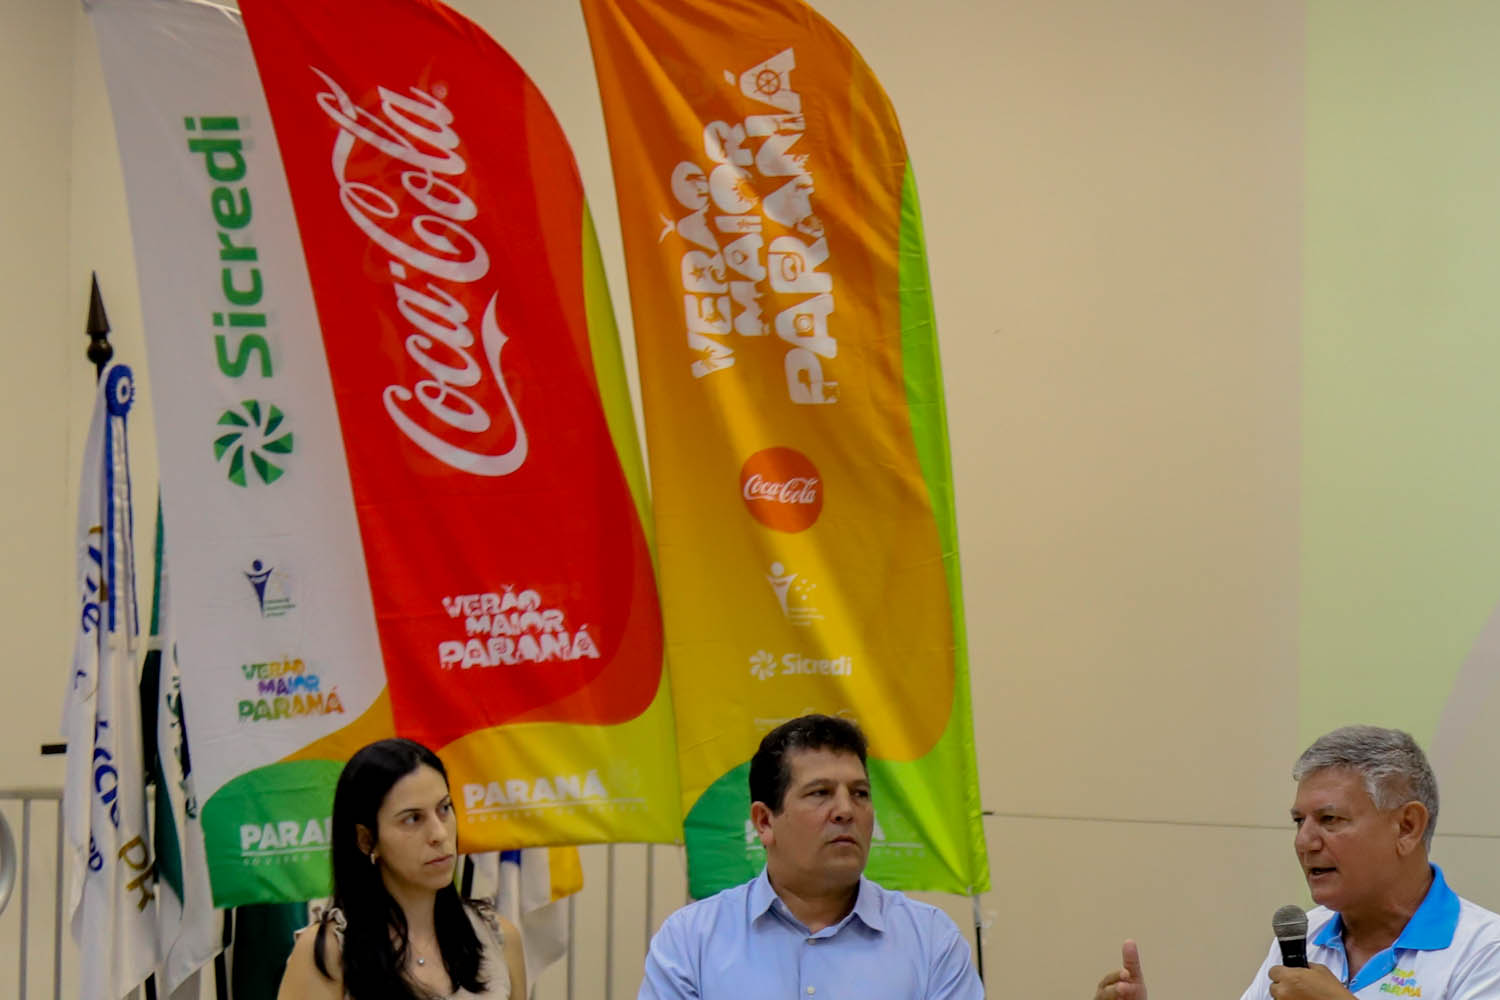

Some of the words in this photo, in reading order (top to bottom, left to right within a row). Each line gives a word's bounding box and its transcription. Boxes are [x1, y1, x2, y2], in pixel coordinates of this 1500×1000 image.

[703, 119, 771, 337] MAIOR
[722, 47, 840, 405] PARANÁ
[183, 115, 273, 379] Sicredi
[308, 64, 529, 477] Coca-Cola
[743, 473, 818, 504] Coca-Cola
[465, 609, 565, 637] MAIOR
[438, 624, 601, 670] PARANÁ
[781, 653, 853, 676] Sicredi
[238, 686, 345, 722] PARANÁ
[257, 674, 320, 696] MAIOR
[462, 769, 608, 809] PARANÁ
